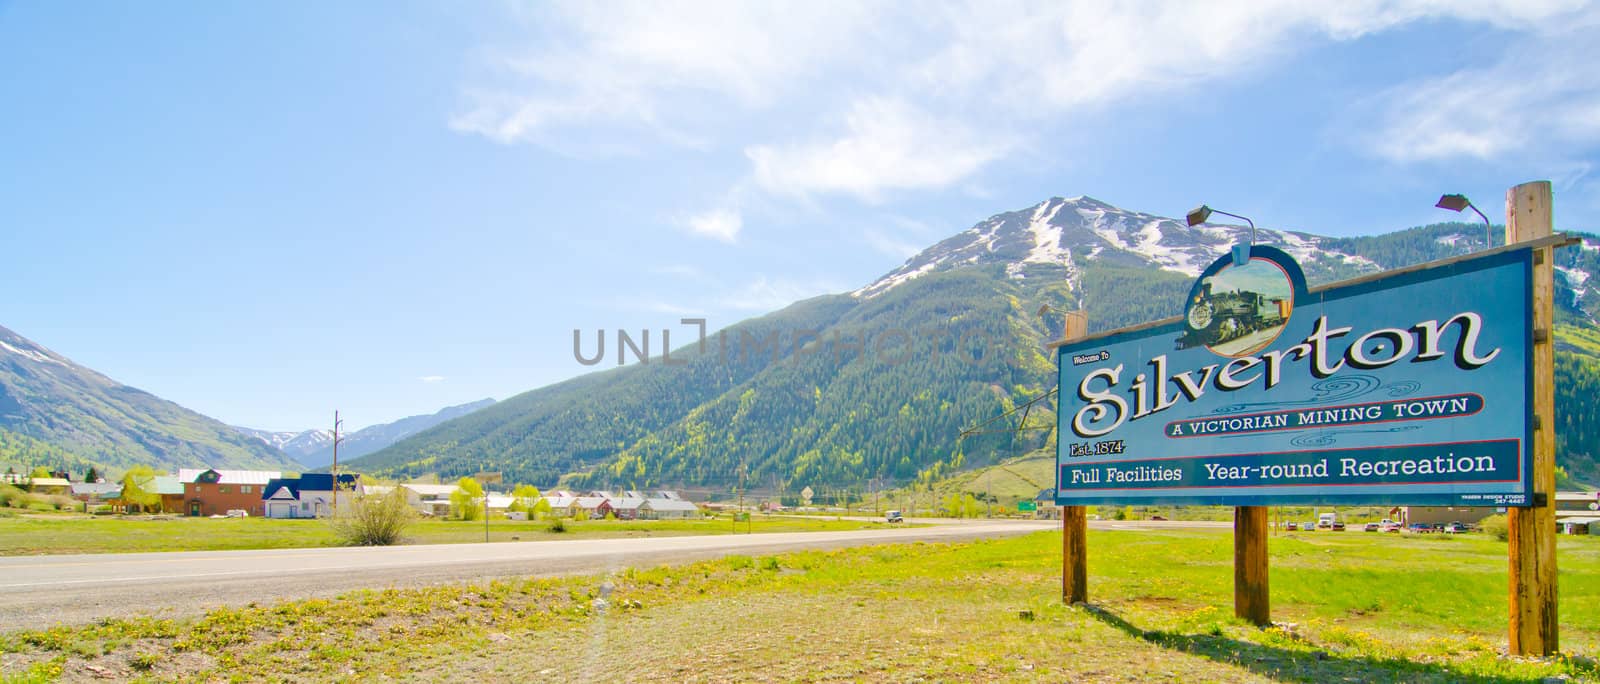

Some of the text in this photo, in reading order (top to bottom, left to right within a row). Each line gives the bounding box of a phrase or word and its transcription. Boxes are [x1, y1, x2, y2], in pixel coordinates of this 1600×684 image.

[1074, 351, 1110, 365] Welcome To
[1072, 311, 1501, 438] Silverton
[1172, 397, 1469, 436] A VICTORIAN MINING TOWN
[1070, 440, 1126, 457] Est. 1874
[1071, 452, 1497, 484] Full Facilities Year-round Recreation
